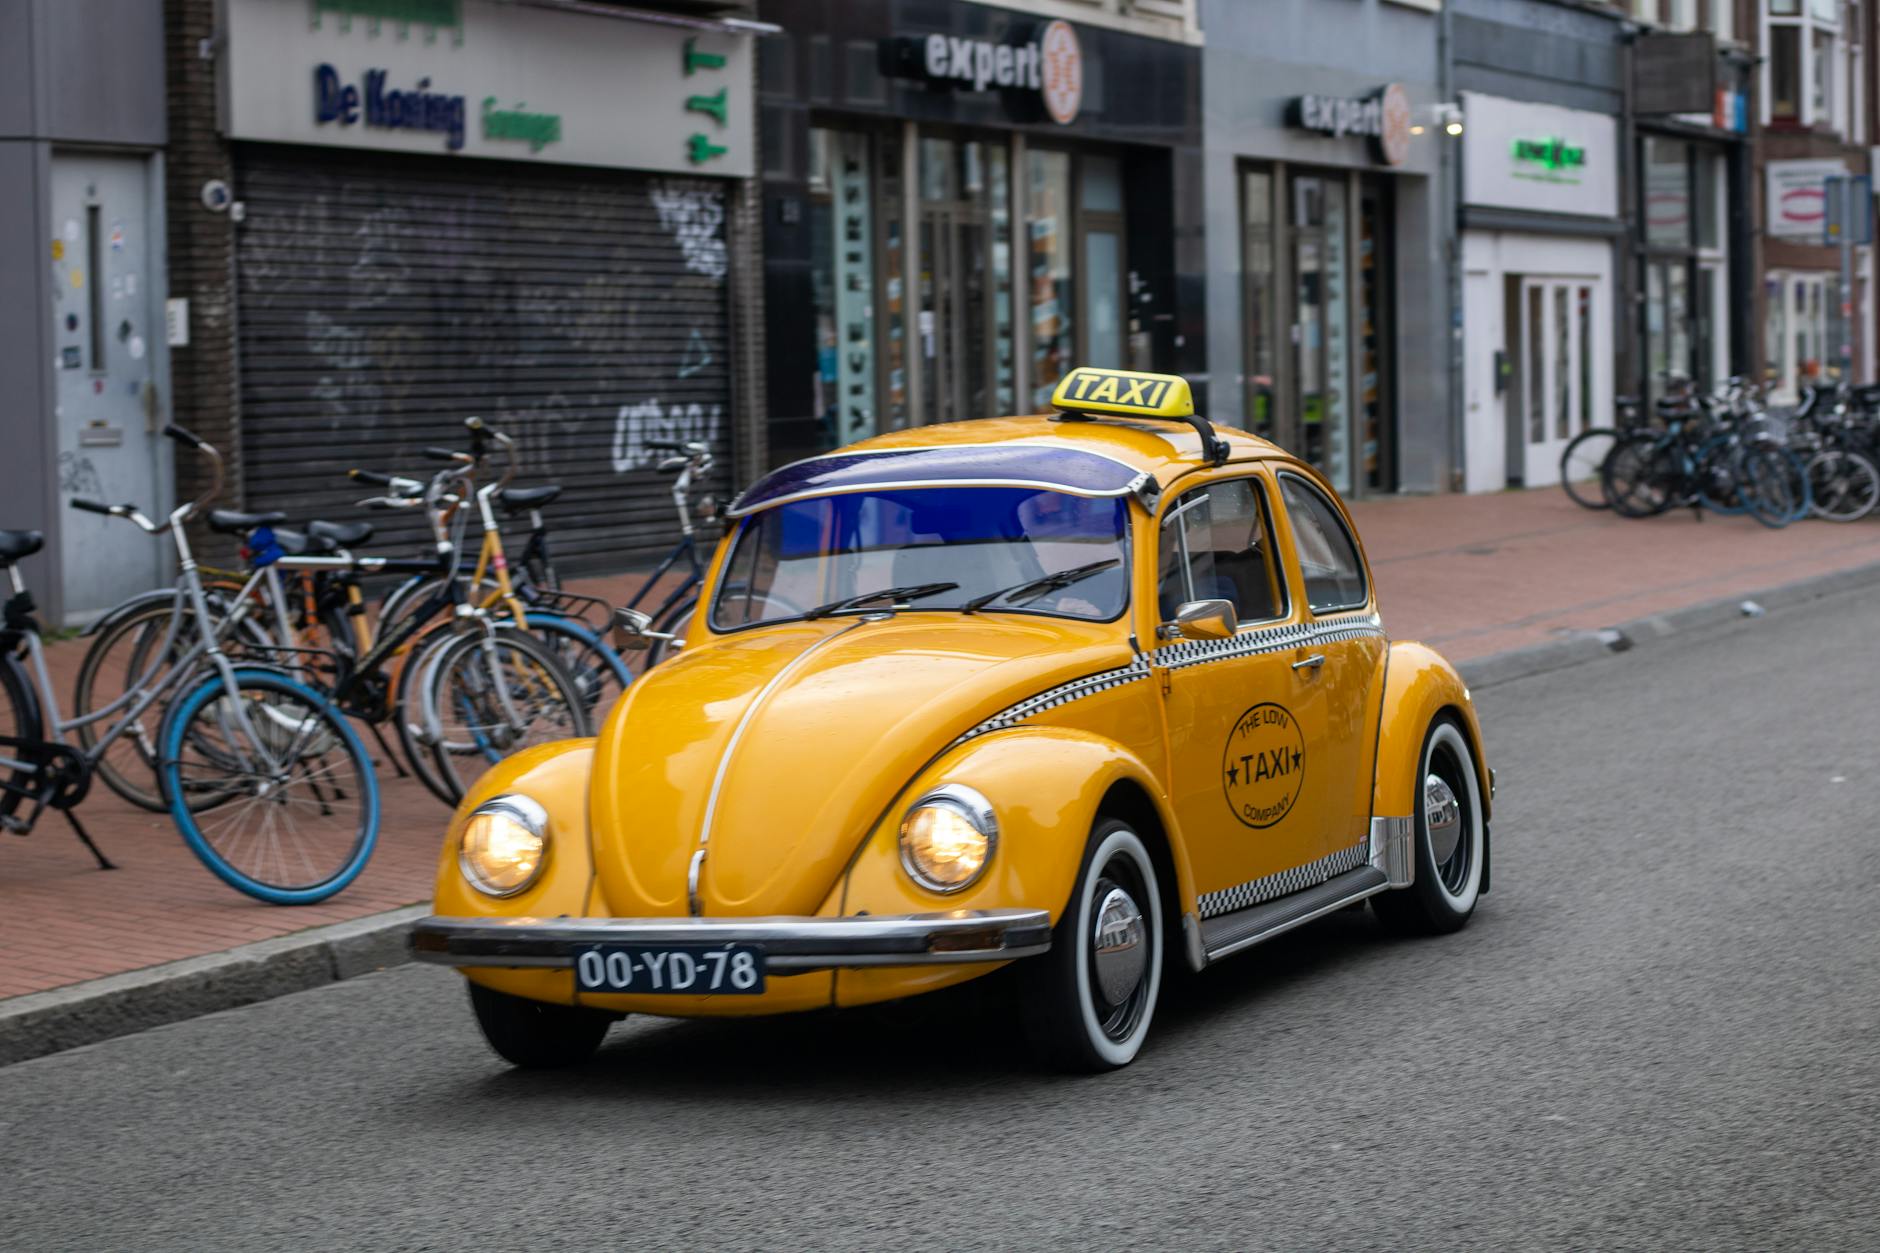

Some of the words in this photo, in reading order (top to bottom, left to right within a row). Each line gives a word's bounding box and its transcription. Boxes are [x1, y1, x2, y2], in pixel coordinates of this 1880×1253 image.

[926, 33, 1040, 92] expert
[314, 63, 360, 127] De
[1301, 93, 1381, 139] expert
[1074, 373, 1167, 407] TAXI
[1239, 711, 1261, 738] THE
[1263, 708, 1289, 730] LOW
[1240, 745, 1291, 785] TAXI
[1243, 792, 1290, 821] COMPANY
[578, 950, 758, 989] 00-YD-78
